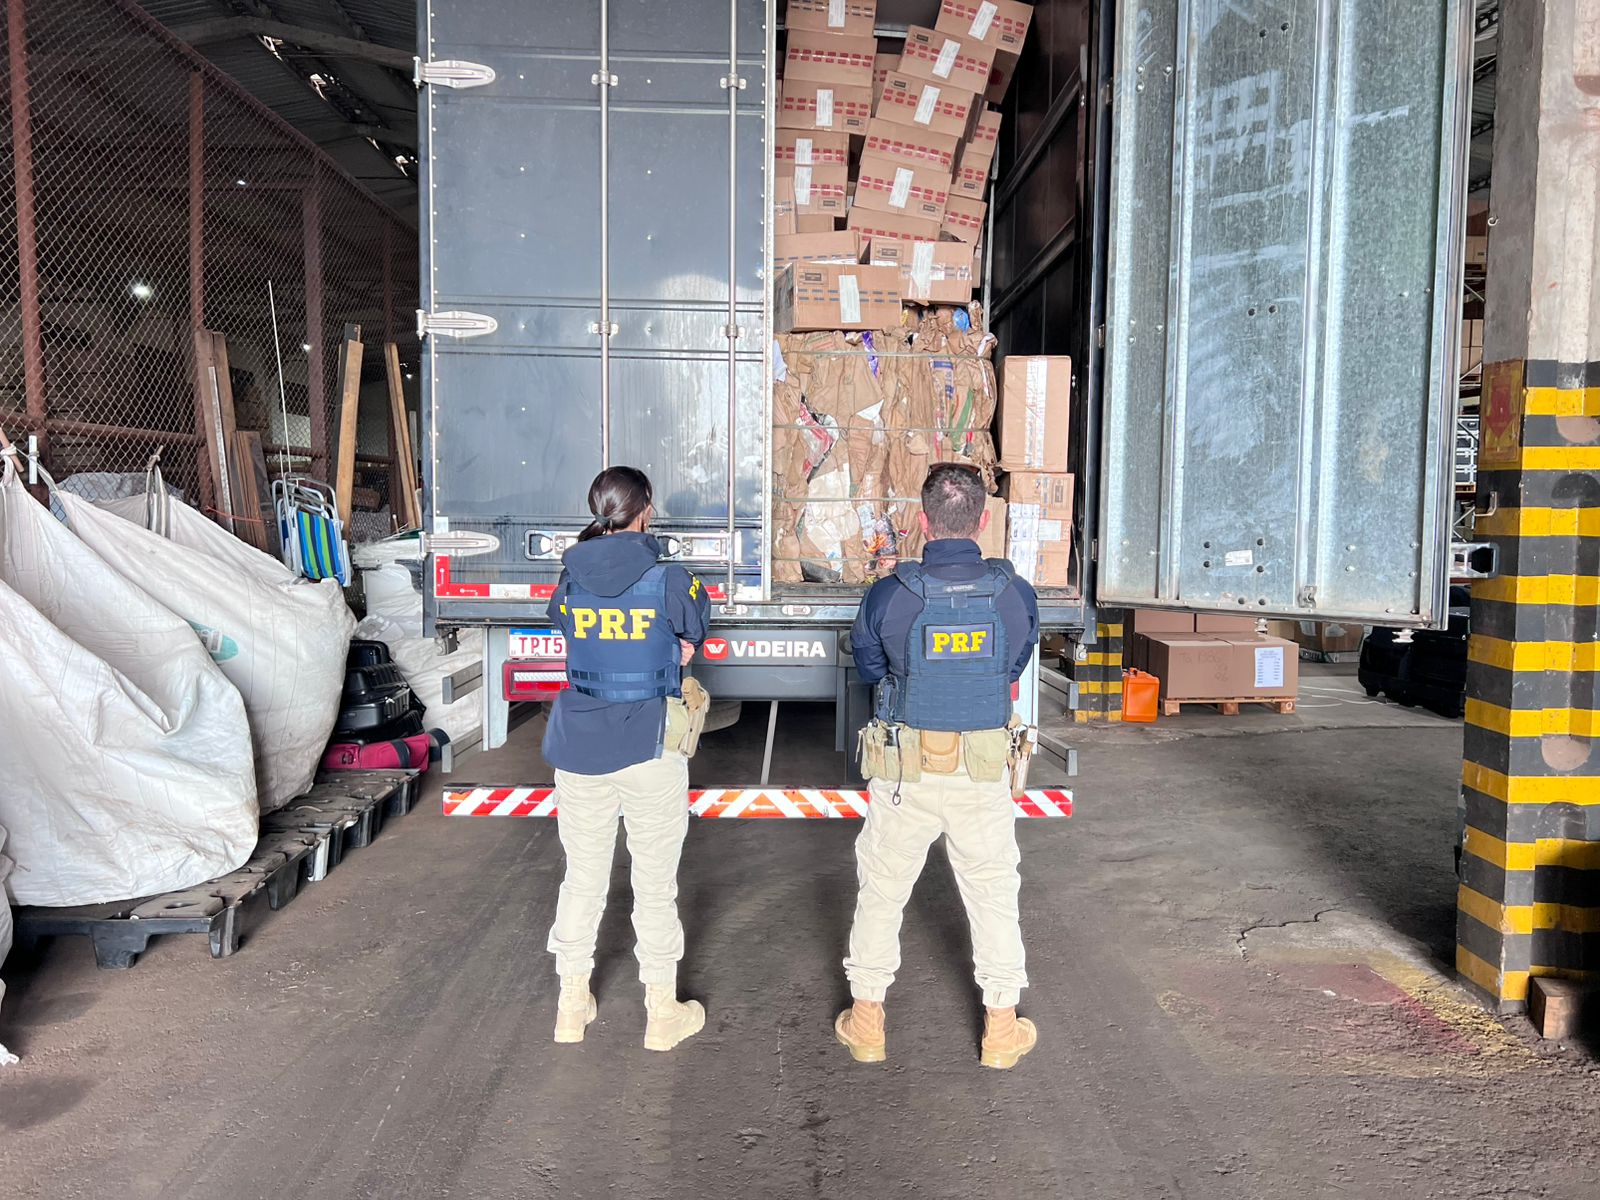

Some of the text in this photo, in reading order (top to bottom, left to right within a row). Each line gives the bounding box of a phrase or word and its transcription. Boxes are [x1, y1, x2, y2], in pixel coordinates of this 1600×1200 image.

[571, 608, 656, 640] PRF
[518, 636, 563, 654] TPT5
[932, 630, 987, 653] PRF
